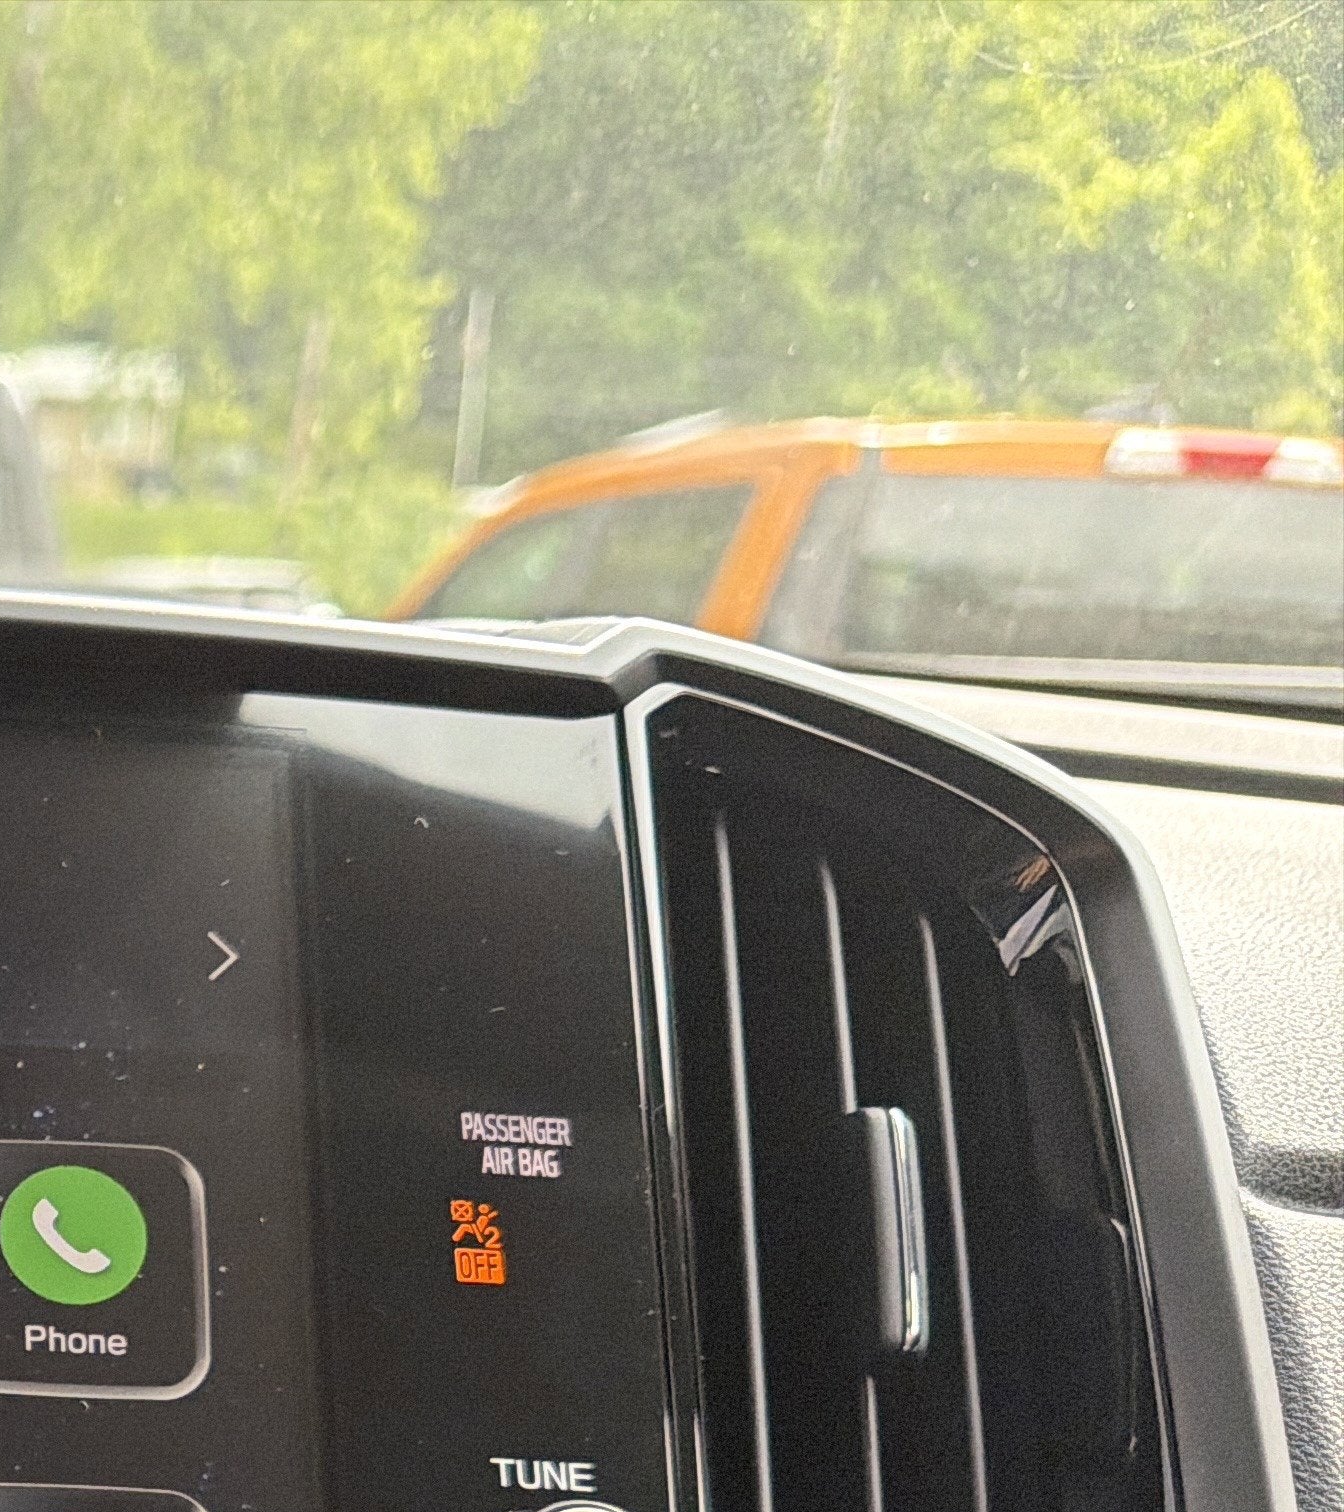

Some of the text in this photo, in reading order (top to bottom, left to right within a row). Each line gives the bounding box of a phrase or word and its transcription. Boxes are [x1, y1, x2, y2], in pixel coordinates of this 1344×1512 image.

[460, 1112, 572, 1146] PASSENGER
[480, 1145, 562, 1179] AIR BAG
[458, 1252, 500, 1280] OFF
[23, 1324, 129, 1357] Phone
[488, 1456, 598, 1493] TUNE
